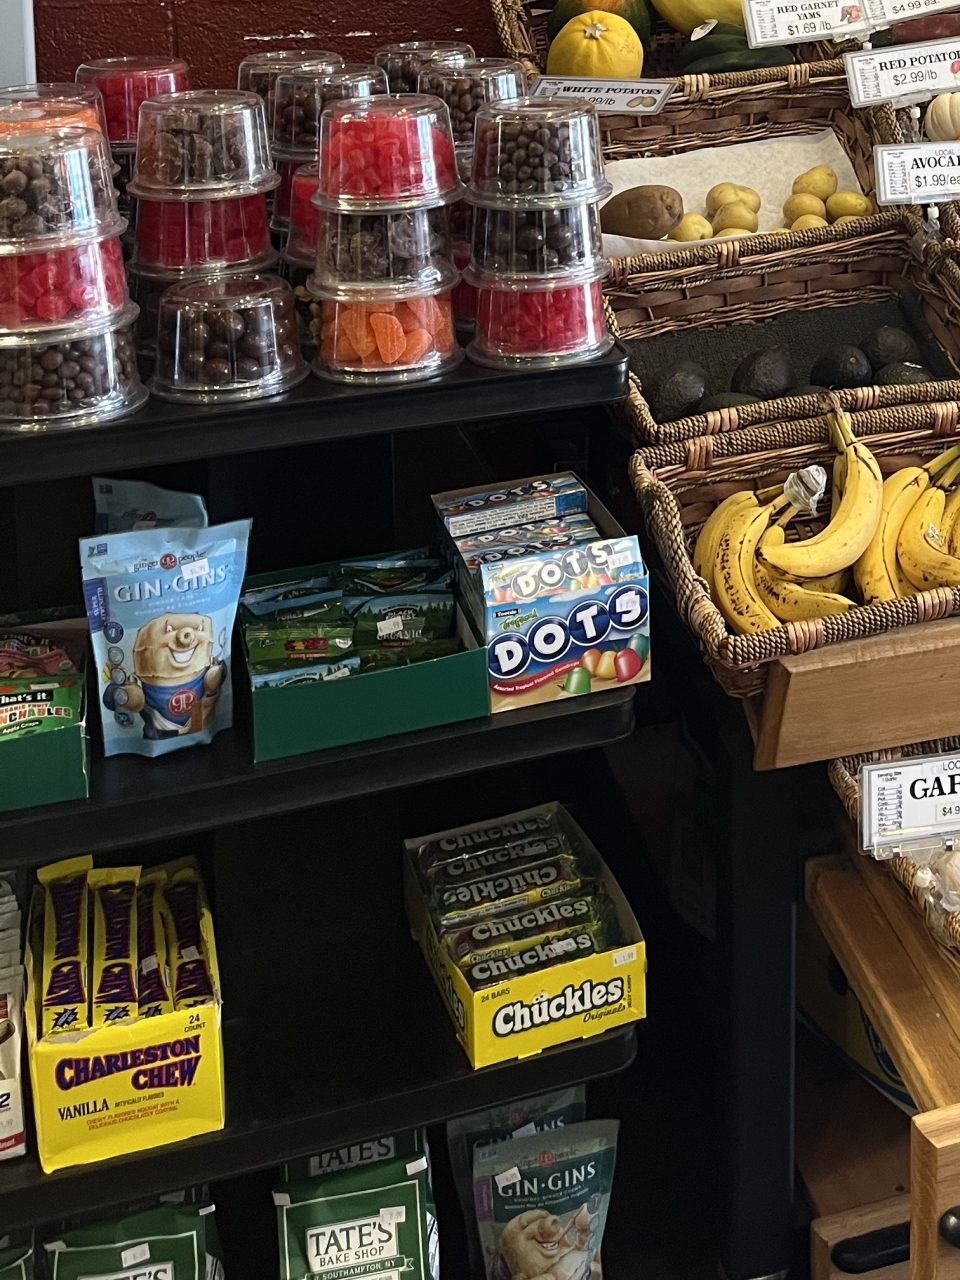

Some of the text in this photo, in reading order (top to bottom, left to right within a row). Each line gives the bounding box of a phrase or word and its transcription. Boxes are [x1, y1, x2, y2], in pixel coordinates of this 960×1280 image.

[776, 0, 840, 14] RED GARNET
[892, 0, 922, 14] $4.99
[797, 10, 822, 20] YAMS
[787, 22, 817, 36] $1.69
[879, 58, 908, 72] RED
[892, 70, 938, 86] $2.99/lb
[562, 86, 604, 94] WHITE
[605, 87, 662, 95] POTATOES
[934, 148, 956, 156] LOCAL
[468, 480, 549, 508] DOTS
[515, 544, 608, 596] DOTS
[0, 693, 32, 704] hat's
[491, 988, 510, 1001] BARS
[188, 1014, 200, 1025] 24
[582, 1004, 626, 1024] Originals
[184, 1022, 206, 1034] COUNT
[54, 1034, 201, 1092] CHARLESTON
[130, 1054, 202, 1092] CHEW
[58, 1098, 110, 1122] VANILLA
[318, 1138, 392, 1169] TATE'S
[310, 1222, 392, 1258] TATE'S
[319, 1246, 384, 1268] BAKE SHOP
[384, 1259, 396, 1268] NY
